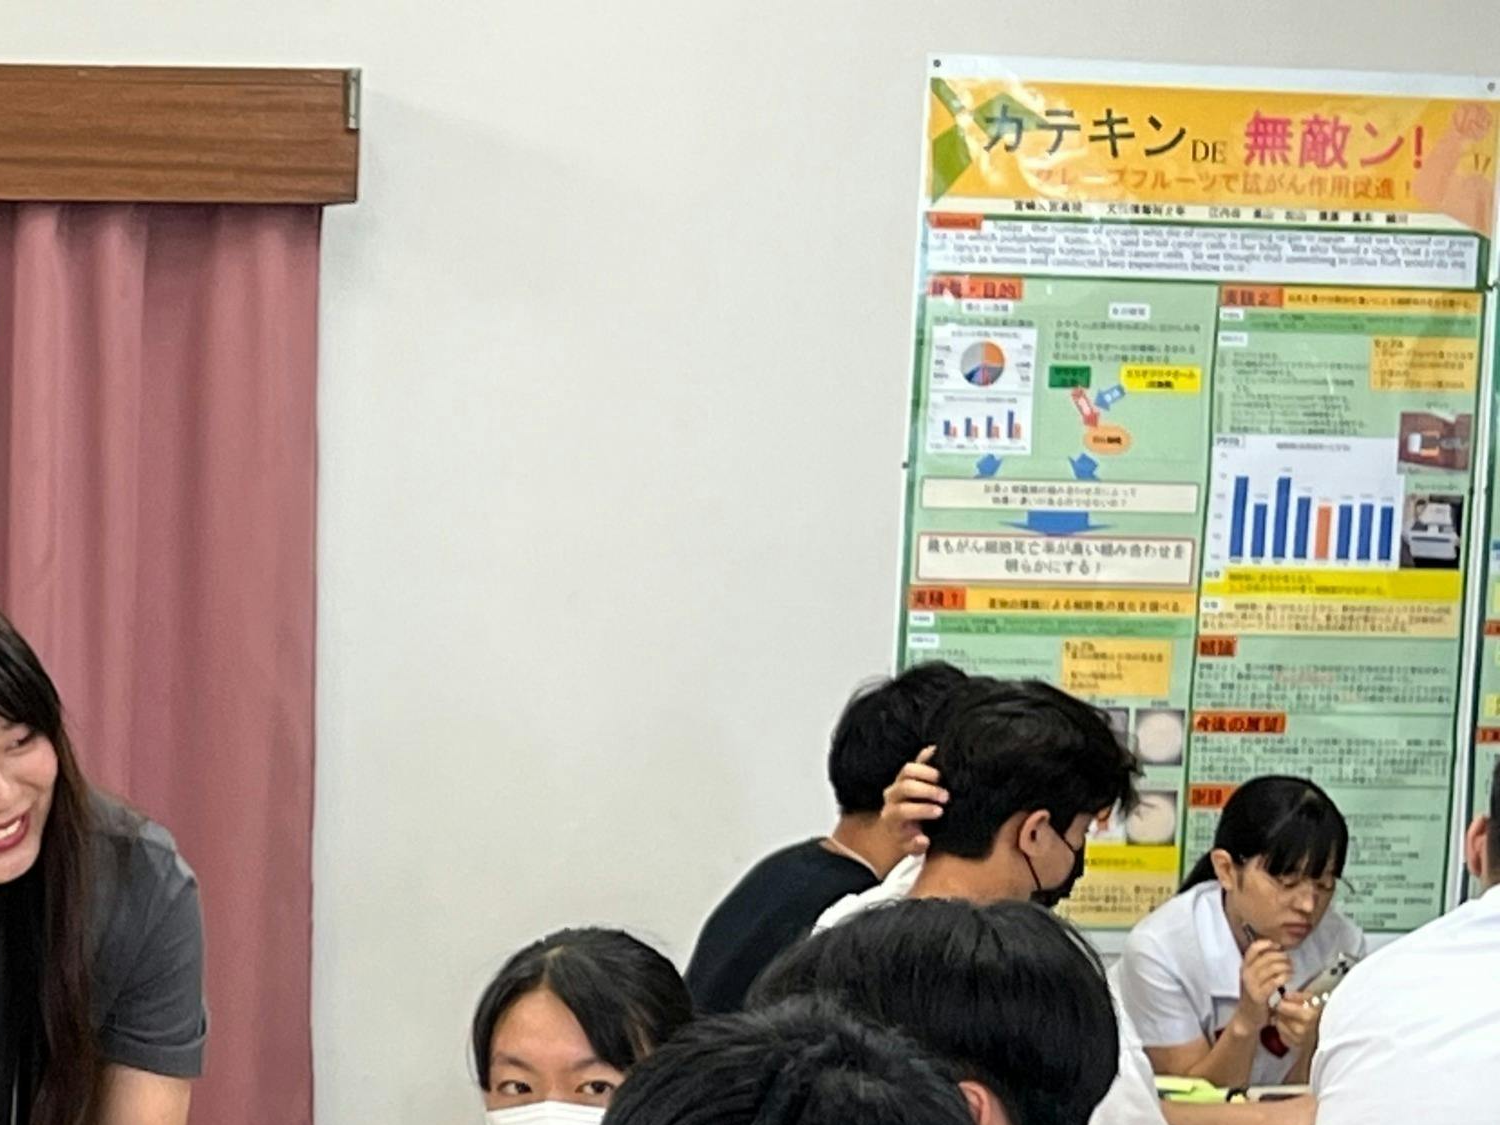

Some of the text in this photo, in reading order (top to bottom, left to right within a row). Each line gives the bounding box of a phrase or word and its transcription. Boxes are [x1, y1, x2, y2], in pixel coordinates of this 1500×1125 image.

[983, 103, 1186, 159] カテキン
[1191, 139, 1227, 164] DE
